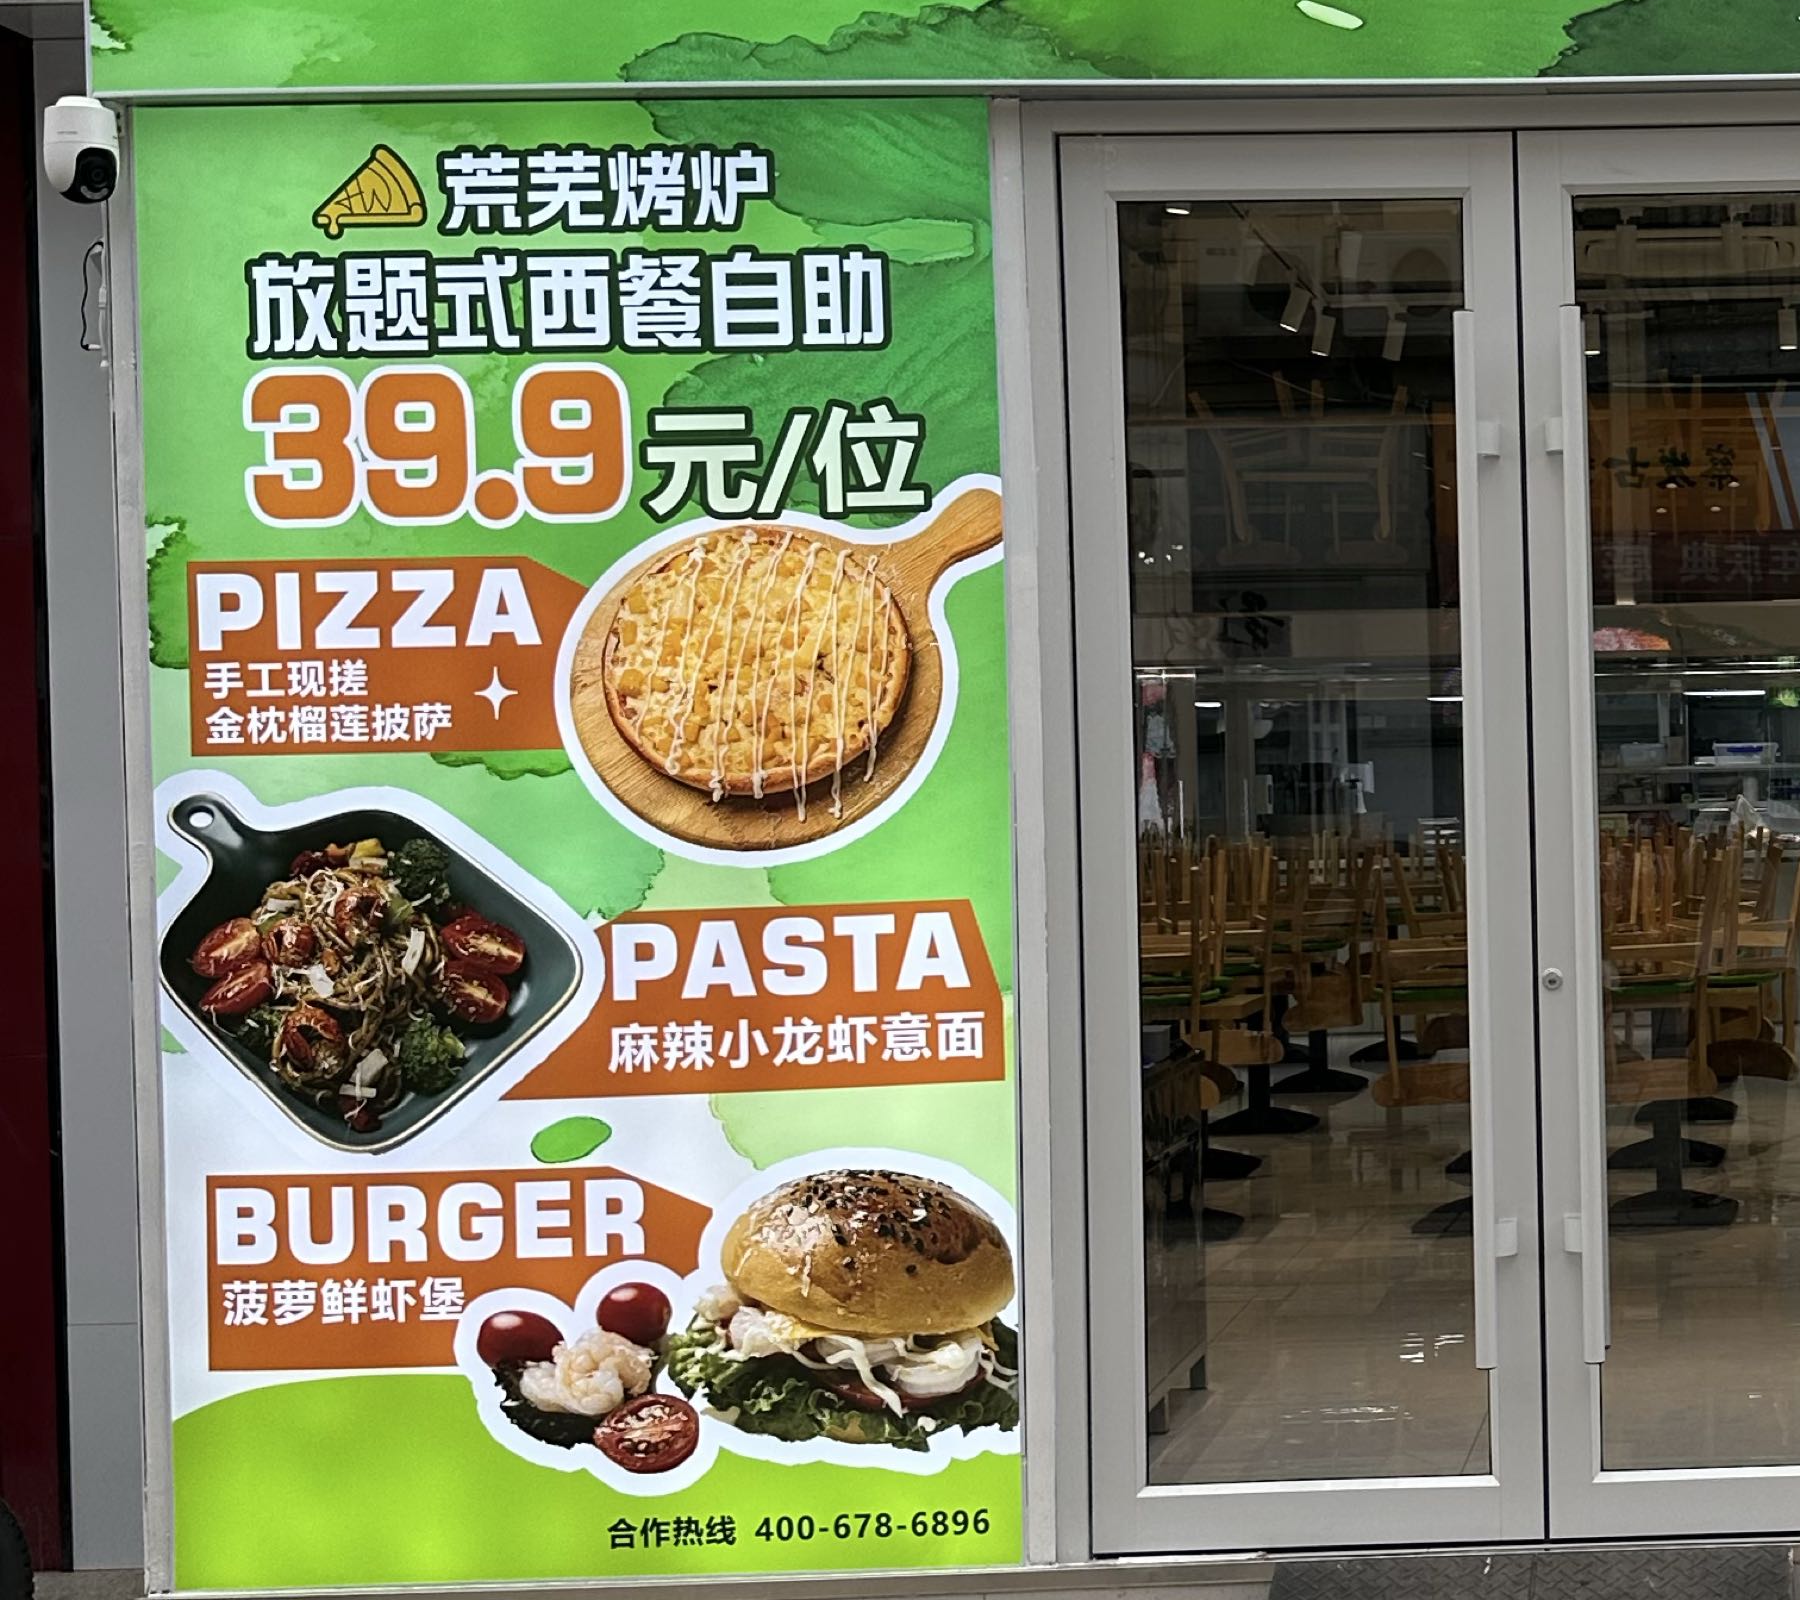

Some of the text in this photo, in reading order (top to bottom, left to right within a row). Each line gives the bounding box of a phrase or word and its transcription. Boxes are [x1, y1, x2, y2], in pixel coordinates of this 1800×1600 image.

[441, 148, 773, 231] 荒芜烤炉
[249, 251, 888, 356] 放题式西餐自助
[197, 568, 541, 650] PIZZA
[204, 660, 368, 698] 手工现搓
[204, 703, 452, 744] 金枕榴莲披萨
[612, 911, 970, 1002] PASTA
[608, 1011, 985, 1073] 麻辣小龙虾意面
[215, 1179, 645, 1266] BURGER
[223, 1279, 465, 1326] 菠萝鲜虾堡
[608, 1509, 991, 1550] 合作热线 400-678-6896
